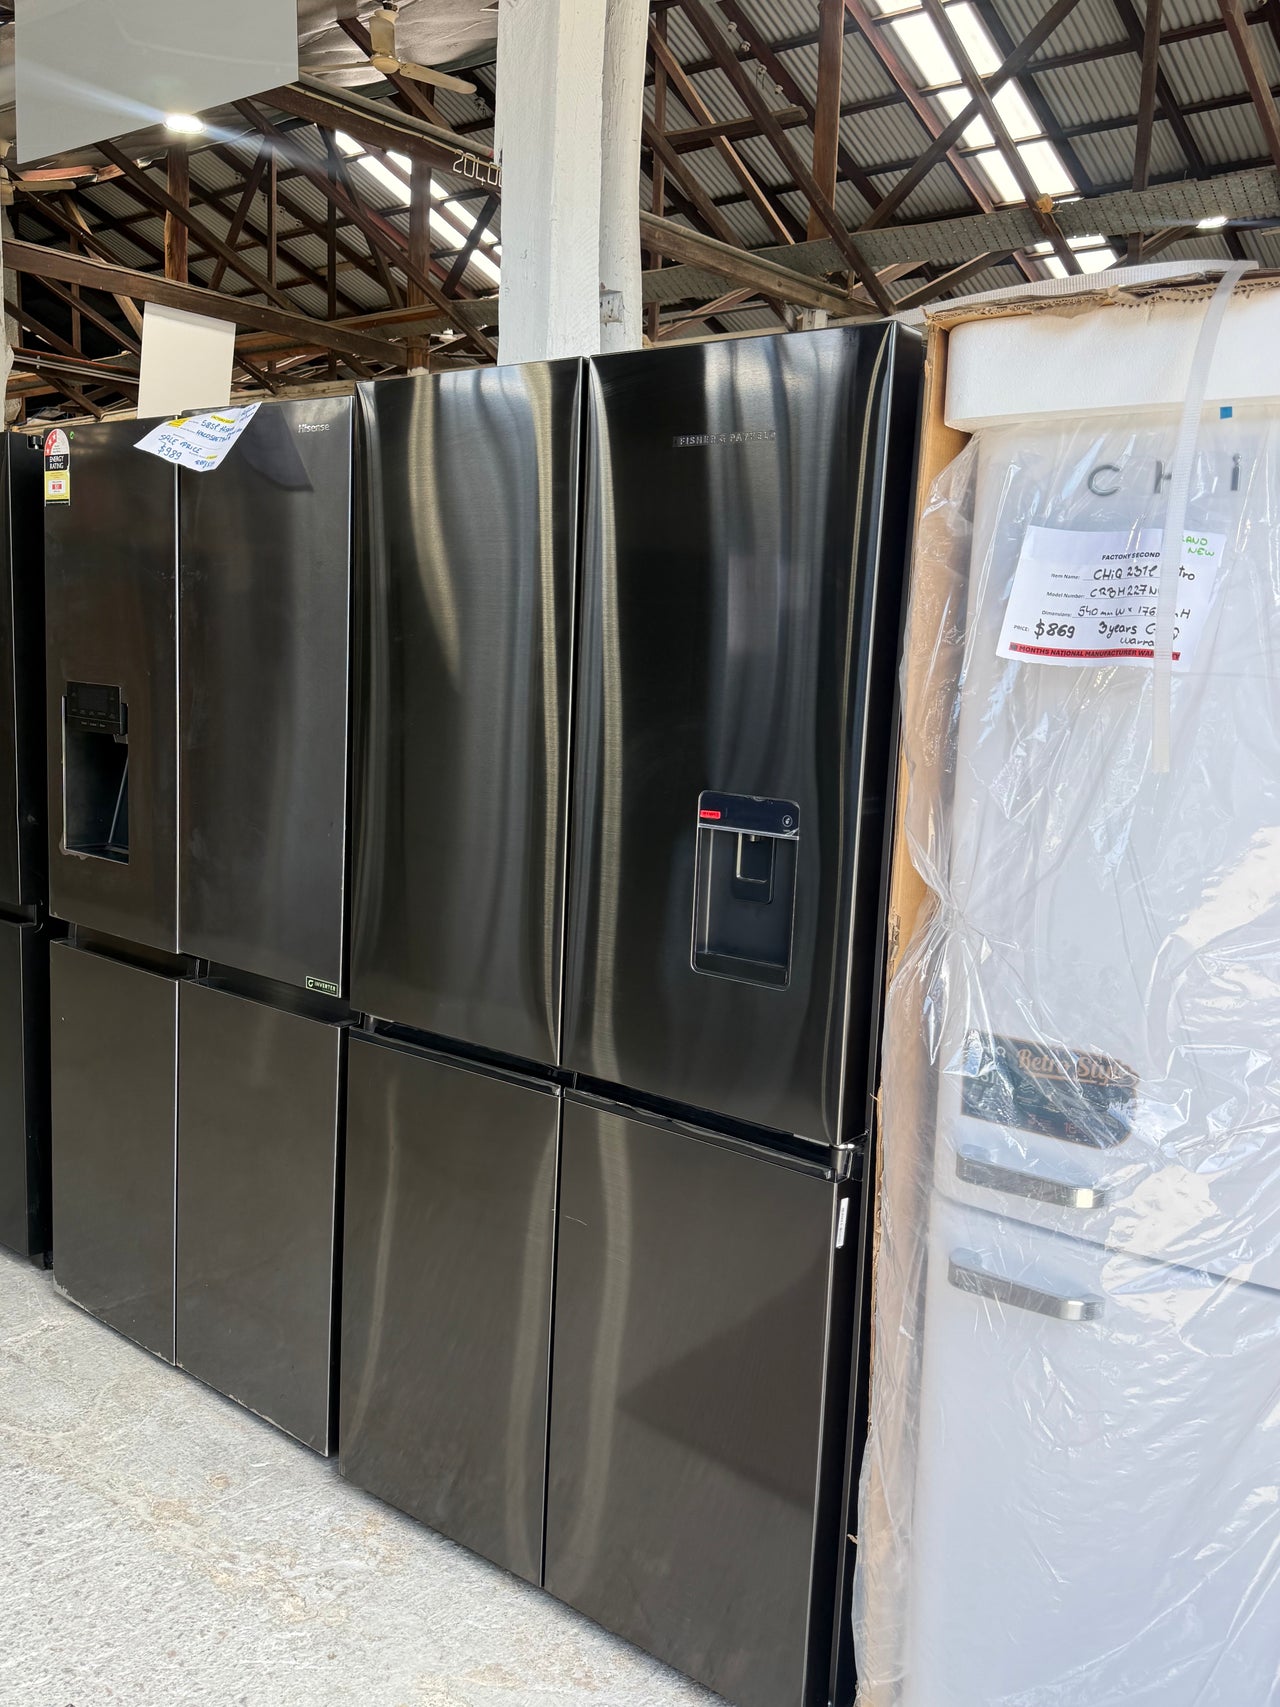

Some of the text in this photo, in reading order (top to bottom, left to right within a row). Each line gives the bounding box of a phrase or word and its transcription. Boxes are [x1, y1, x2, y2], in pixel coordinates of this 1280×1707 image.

[298, 423, 330, 433] Hisense
[158, 434, 179, 445] SALE
[180, 441, 202, 454] PRICE
[680, 434, 716, 445] FISHER
[157, 441, 182, 460] $989
[49, 455, 64, 463] ENERGY
[49, 462, 64, 470] RATING
[1187, 546, 1215, 557] NEW
[1093, 567, 1123, 580] CHiQ
[1013, 624, 1029, 632] PRICE:
[1034, 618, 1075, 639] $869
[1120, 637, 1154, 647] warra
[1019, 645, 1050, 655] MONTHS
[1051, 649, 1084, 657] NATIONAL
[1085, 648, 1137, 657] MANUFACTURER
[314, 981, 336, 991] INVERTER
